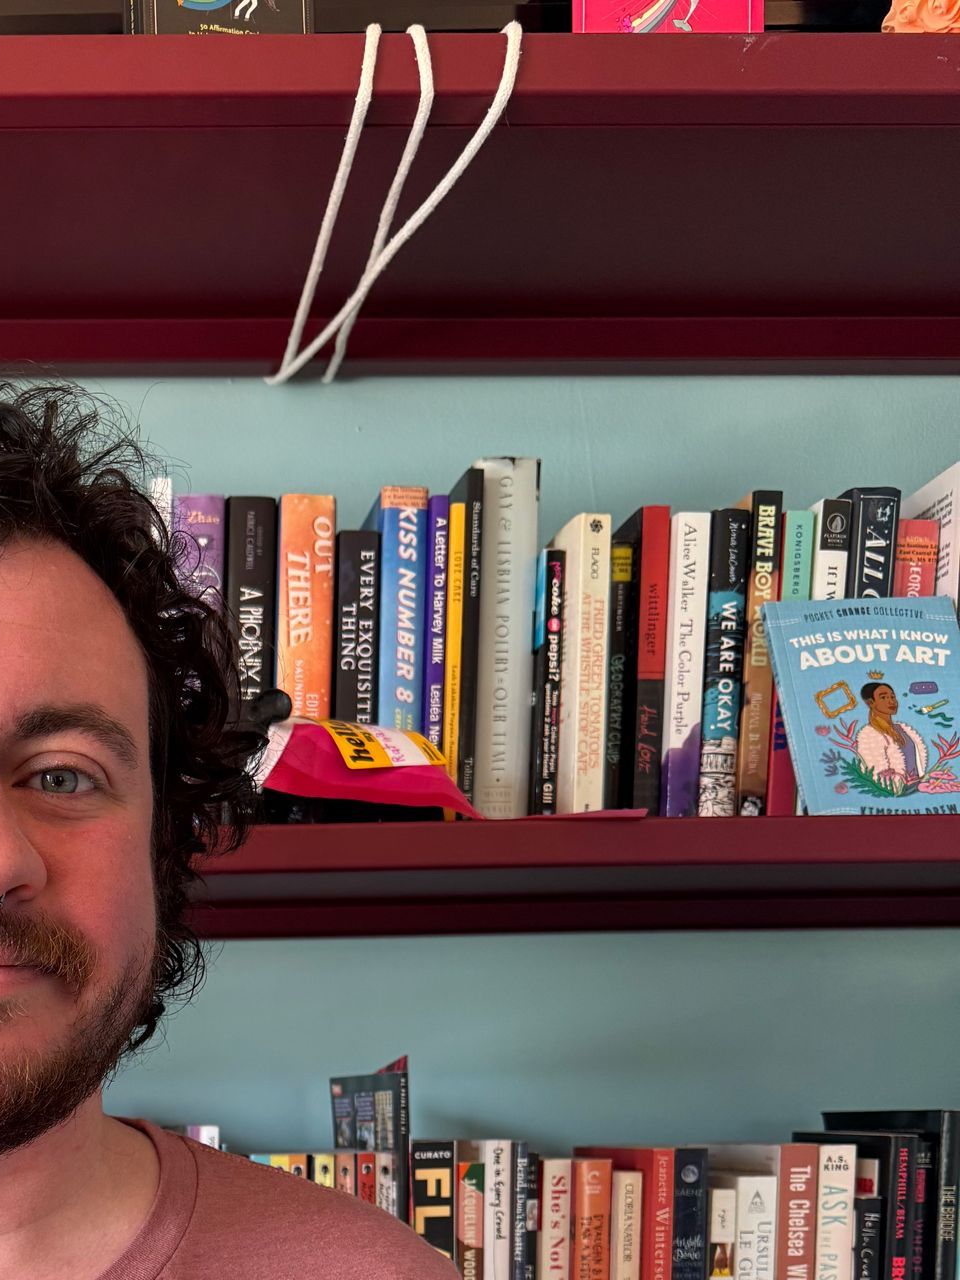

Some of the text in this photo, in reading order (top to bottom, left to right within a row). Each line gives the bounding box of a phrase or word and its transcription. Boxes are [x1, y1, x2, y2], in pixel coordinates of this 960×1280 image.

[187, 512, 220, 525] Zhao
[313, 516, 334, 578] OUT
[590, 547, 601, 580] FLAGG
[792, 524, 804, 597] KONIGSBERG
[239, 587, 263, 601] A
[286, 551, 313, 649] THERE
[359, 551, 375, 612] EVERY
[547, 578, 562, 683] coke pepsi?
[673, 523, 697, 736] Alice Walker The Color Purple
[804, 606, 924, 623] POCKET CHANGE COLLECTIVE
[238, 607, 264, 683] PHOENIX
[341, 603, 357, 672] THING
[789, 628, 949, 649] THIS IS WHAT I KNOW
[800, 643, 952, 671] ABOUT ART
[356, 620, 374, 724] EXQUISITE
[717, 602, 737, 732] WE ARE OKAY
[306, 695, 320, 717] EDIT
[542, 782, 553, 804] Gill
[414, 1150, 452, 1159] CURATO
[823, 1164, 850, 1172] KING
[657, 1155, 671, 1205] Jeanette
[789, 1165, 812, 1192] The
[463, 1178, 481, 1247] JACQUELINE
[549, 1175, 568, 1230] She's
[621, 1183, 636, 1223] GLORIA
[620, 1223, 635, 1263] NAYLOR
[739, 1230, 755, 1253] LE
[787, 1198, 811, 1258] Chelsea
[548, 1236, 565, 1272] Not
